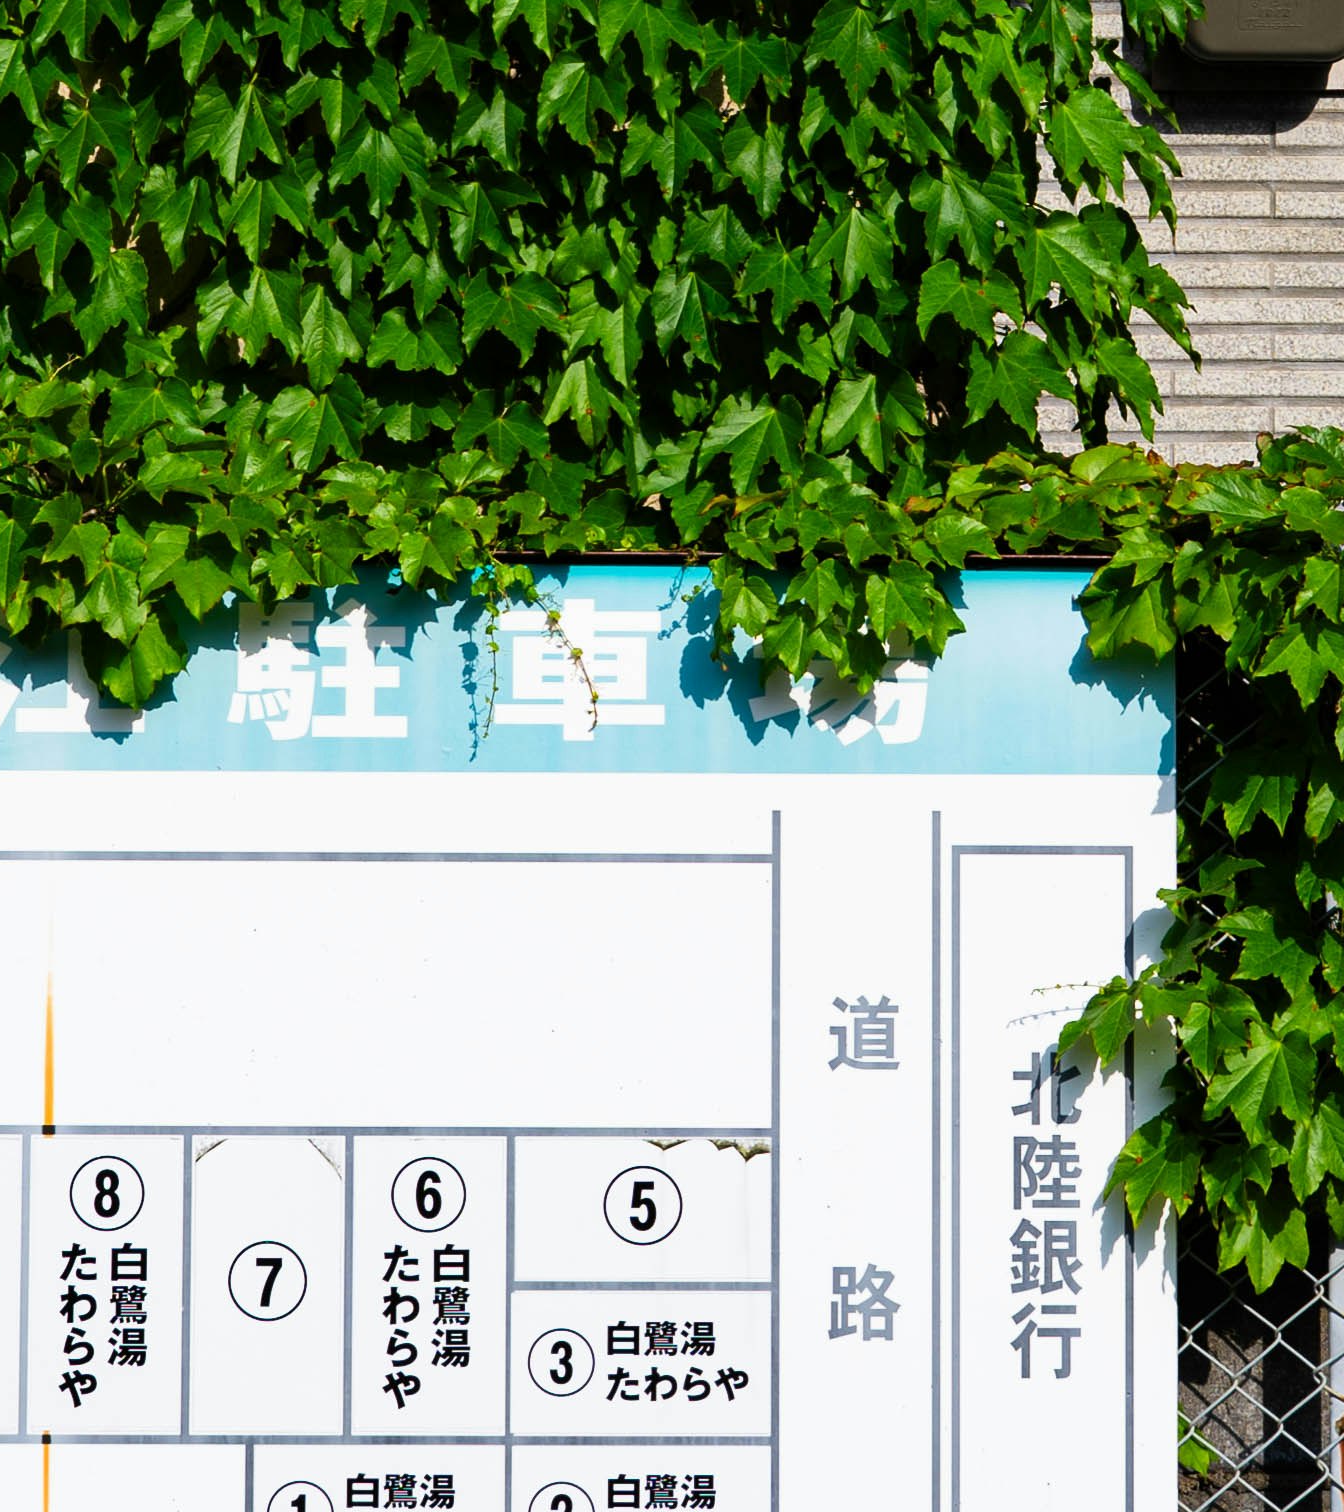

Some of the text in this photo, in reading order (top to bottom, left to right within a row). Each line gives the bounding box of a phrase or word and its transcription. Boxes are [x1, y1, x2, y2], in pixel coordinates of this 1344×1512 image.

[827, 994, 902, 1342] 道路
[1010, 1050, 1083, 1380] 北陸銀行
[57, 1241, 99, 1410] たわらや
[107, 1241, 149, 1368] 白鷺湯
[380, 1243, 423, 1411] たわらや
[429, 1242, 472, 1369] 白鷺湯
[605, 1319, 717, 1358] 白鷺湯
[604, 1365, 751, 1403] たわらや
[344, 1471, 457, 1511] 白鷺湯
[606, 1472, 718, 1511] 白鷺湯
